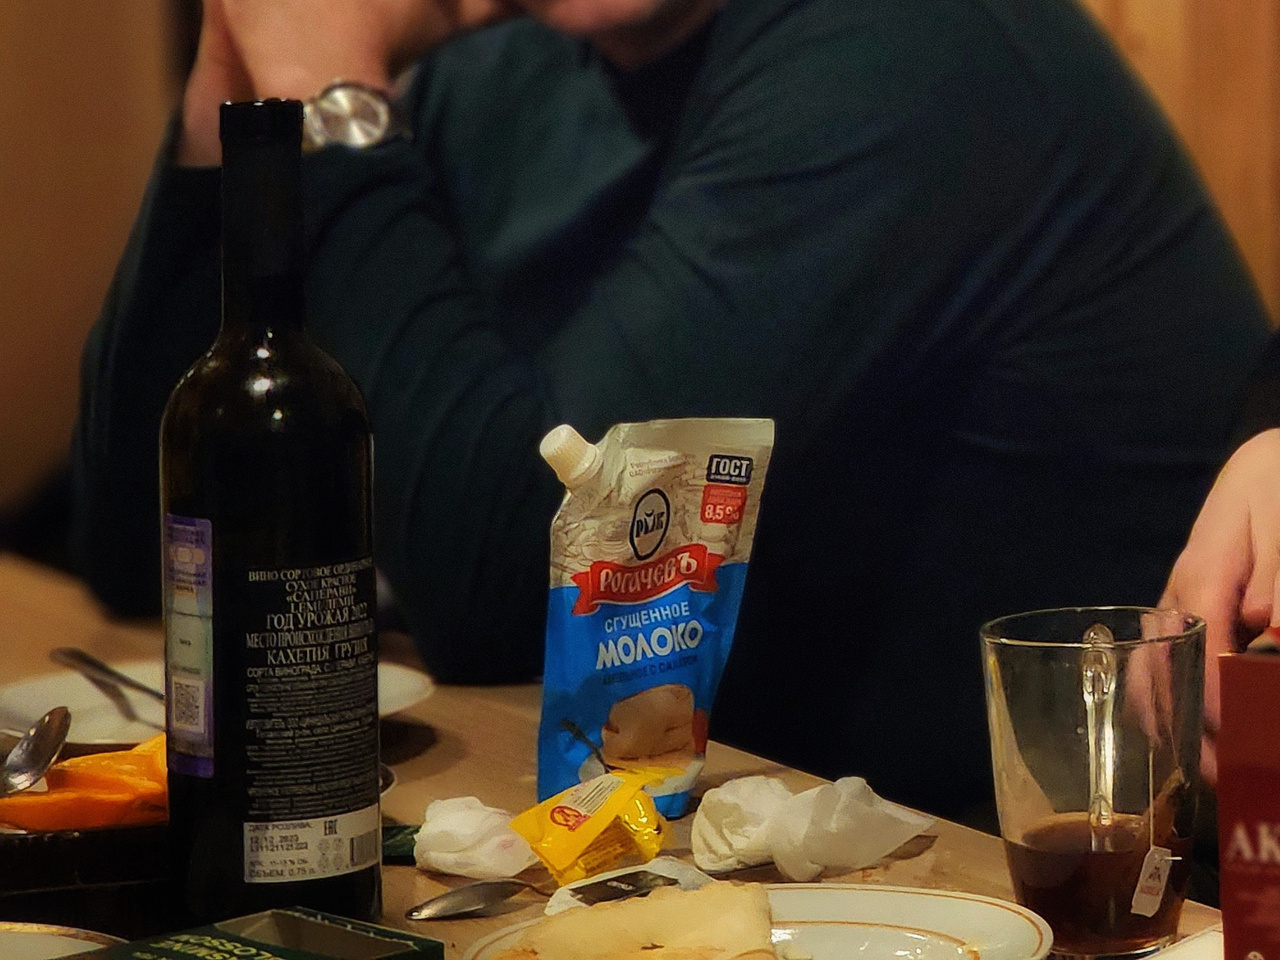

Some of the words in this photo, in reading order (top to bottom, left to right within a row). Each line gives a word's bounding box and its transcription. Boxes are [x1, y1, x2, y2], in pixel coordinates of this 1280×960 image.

[711, 457, 750, 476] ГОСТ
[248, 570, 279, 581] ВИНО
[266, 612, 294, 631] ГОД
[297, 606, 350, 628] УРОЖАЯ
[604, 601, 691, 633] СГУЩЕННОЕ
[245, 632, 277, 649] МЕСТО
[266, 644, 330, 665] КАХЕТИЯ
[335, 637, 369, 659] ГРУЗИЯ
[596, 619, 704, 670] МОЛОКО
